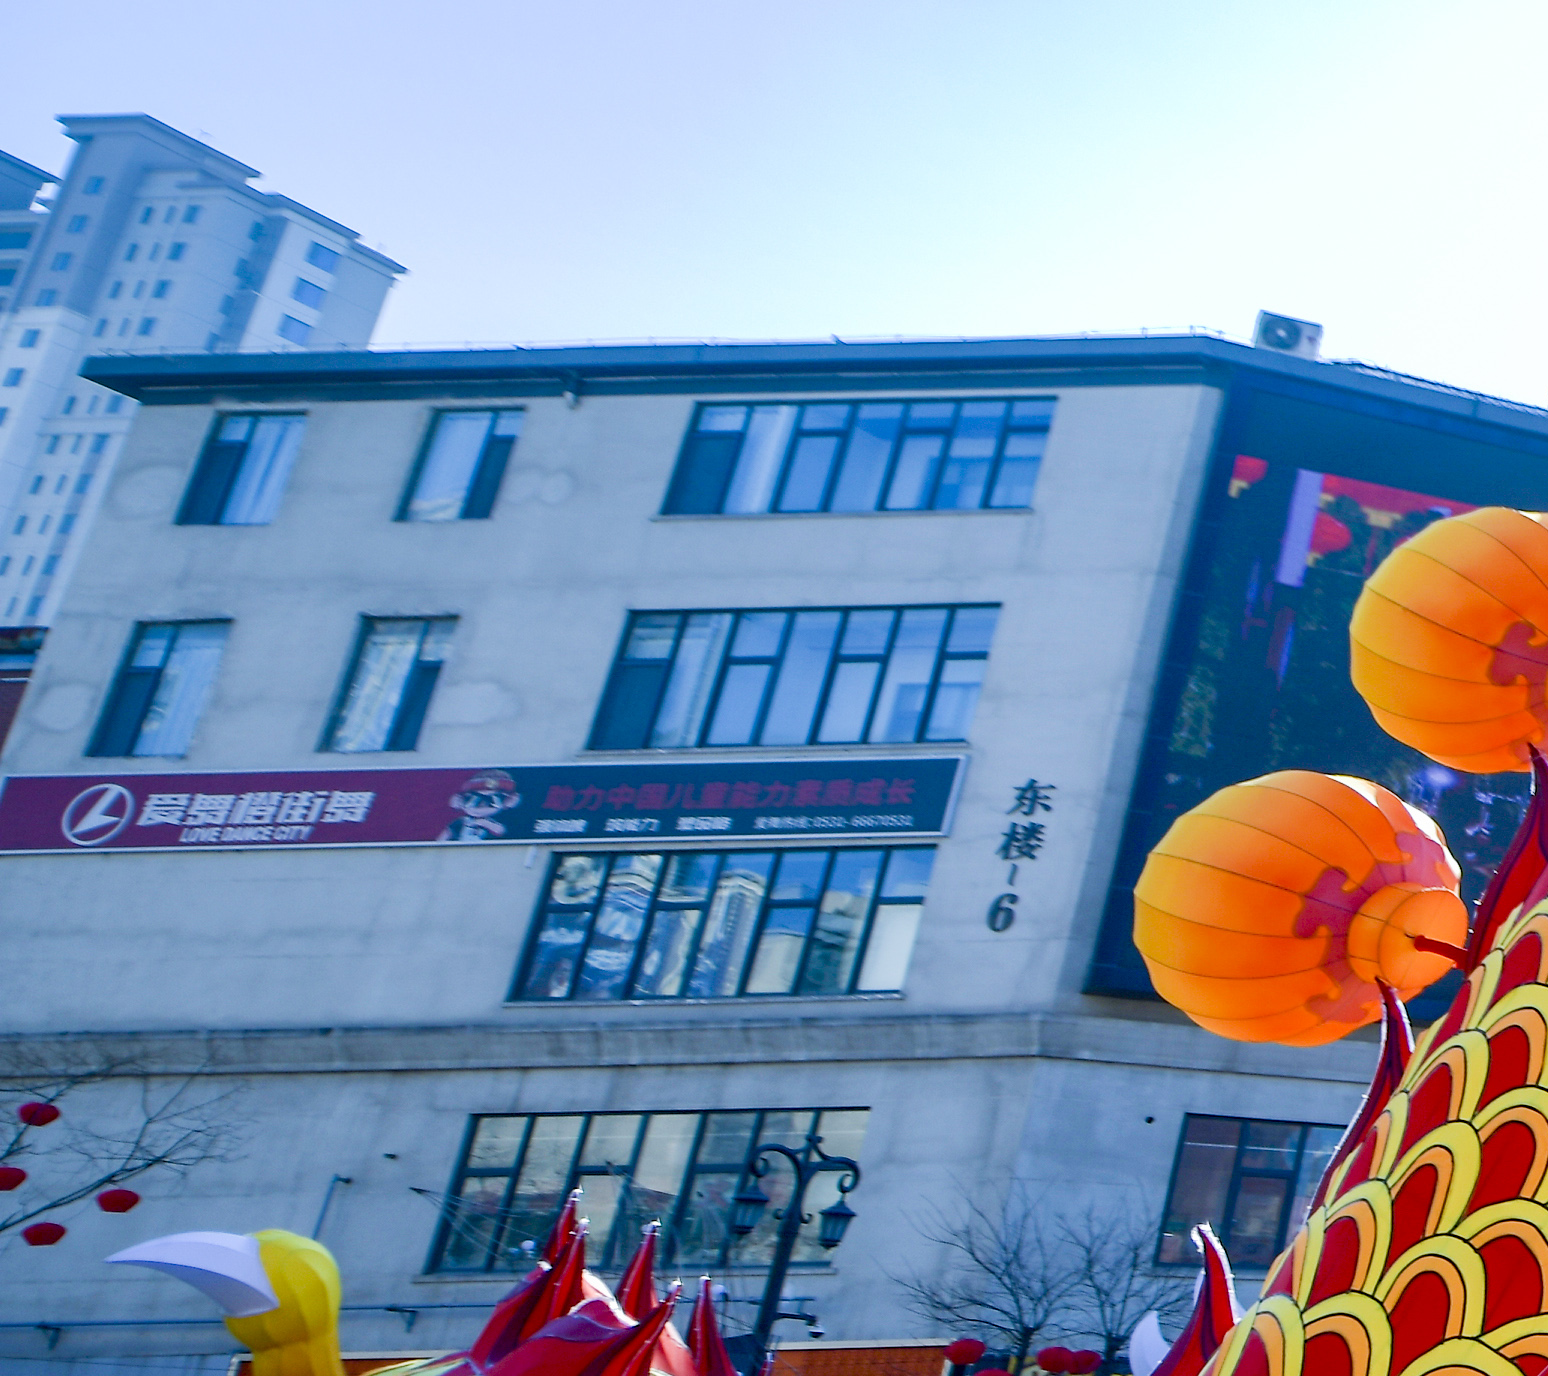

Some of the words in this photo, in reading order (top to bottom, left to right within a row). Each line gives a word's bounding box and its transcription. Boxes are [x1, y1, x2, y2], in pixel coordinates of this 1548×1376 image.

[178, 826, 222, 843] LOVE
[220, 825, 275, 843] DANCE
[273, 824, 315, 842] CITY
